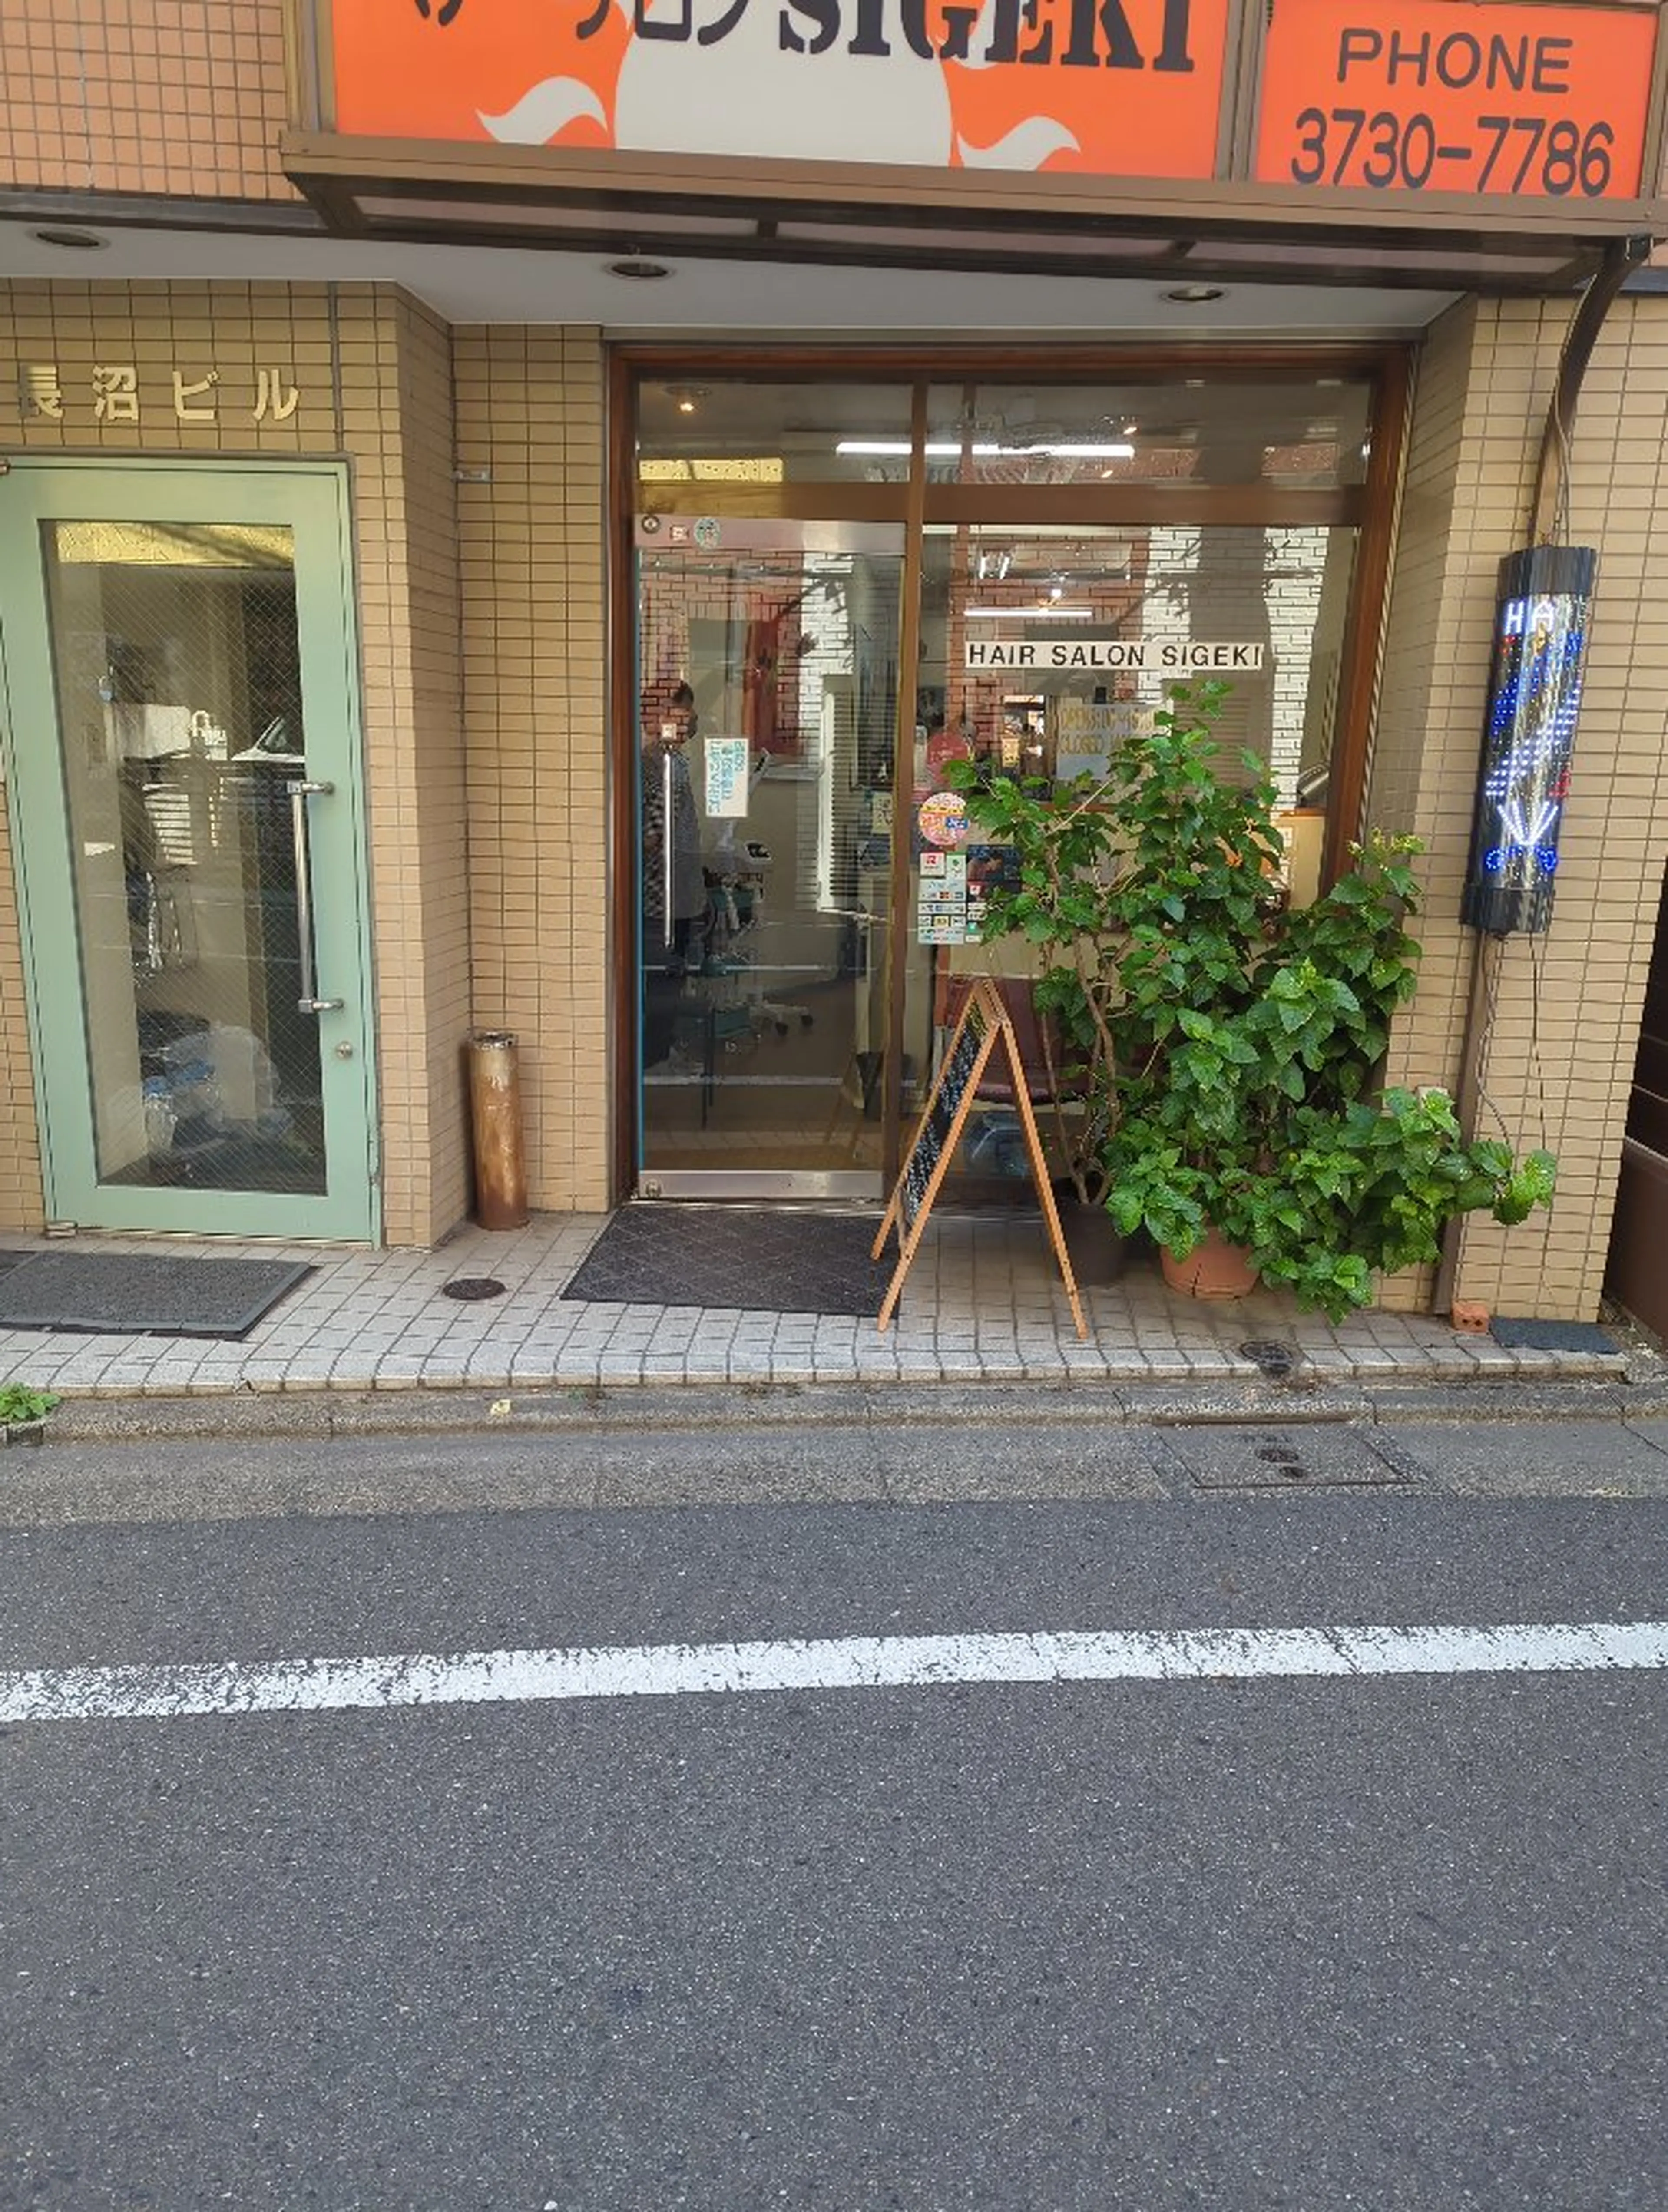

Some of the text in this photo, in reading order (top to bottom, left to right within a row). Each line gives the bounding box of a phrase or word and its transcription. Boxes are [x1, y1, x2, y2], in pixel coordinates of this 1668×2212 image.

[1337, 28, 1573, 93] PHONE
[1291, 107, 1614, 197] 3730-7786
[18, 364, 299, 420] 長沼ビル
[970, 644, 1259, 666] HAIR SALON SIGEKI
